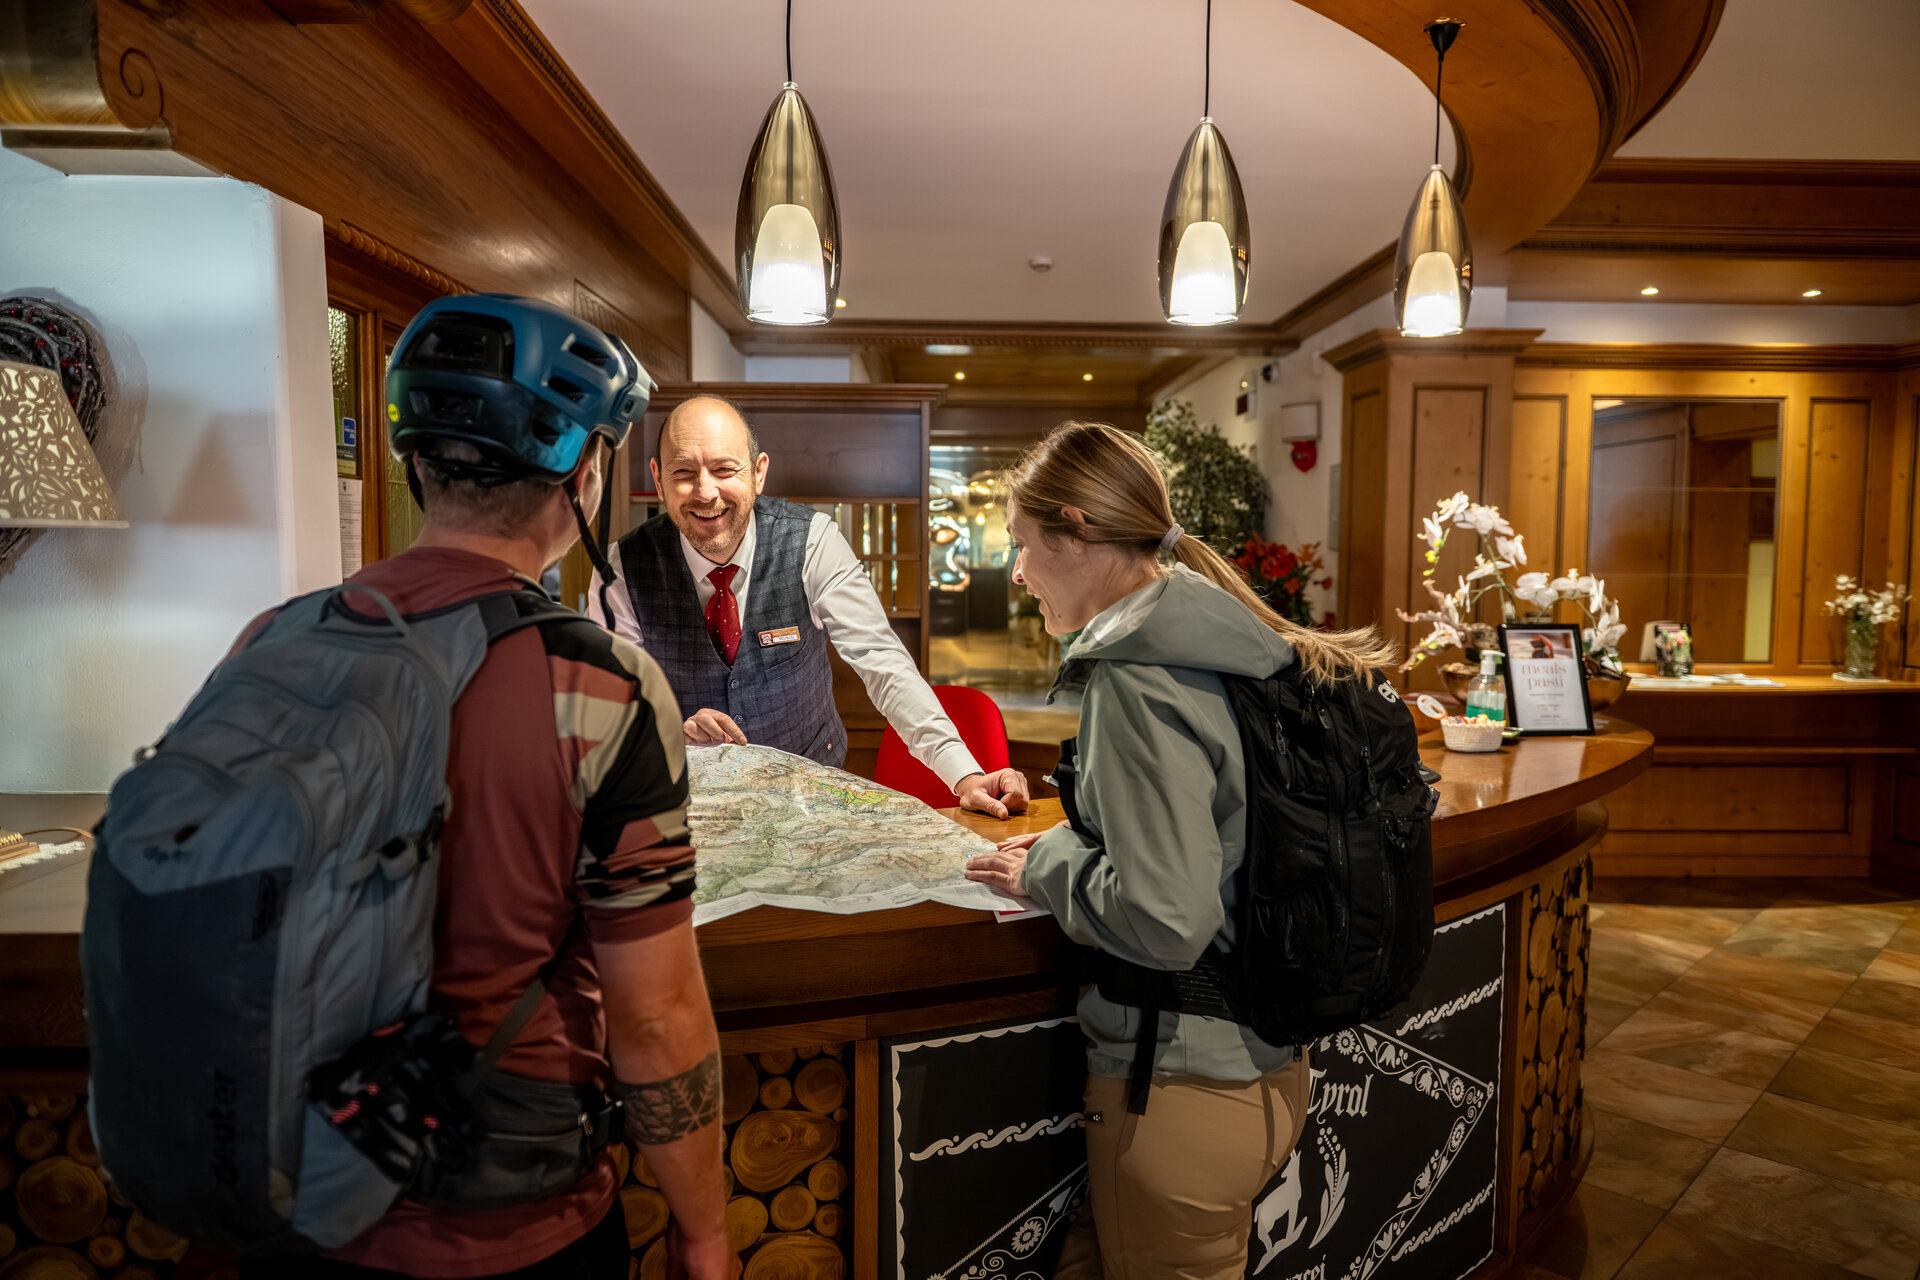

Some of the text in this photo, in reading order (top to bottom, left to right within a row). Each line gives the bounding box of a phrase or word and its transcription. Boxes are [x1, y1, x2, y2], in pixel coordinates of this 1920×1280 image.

[1521, 662, 1567, 675] meals
[1528, 675, 1563, 690] pasti
[1307, 1068, 1374, 1124] Tyrol
